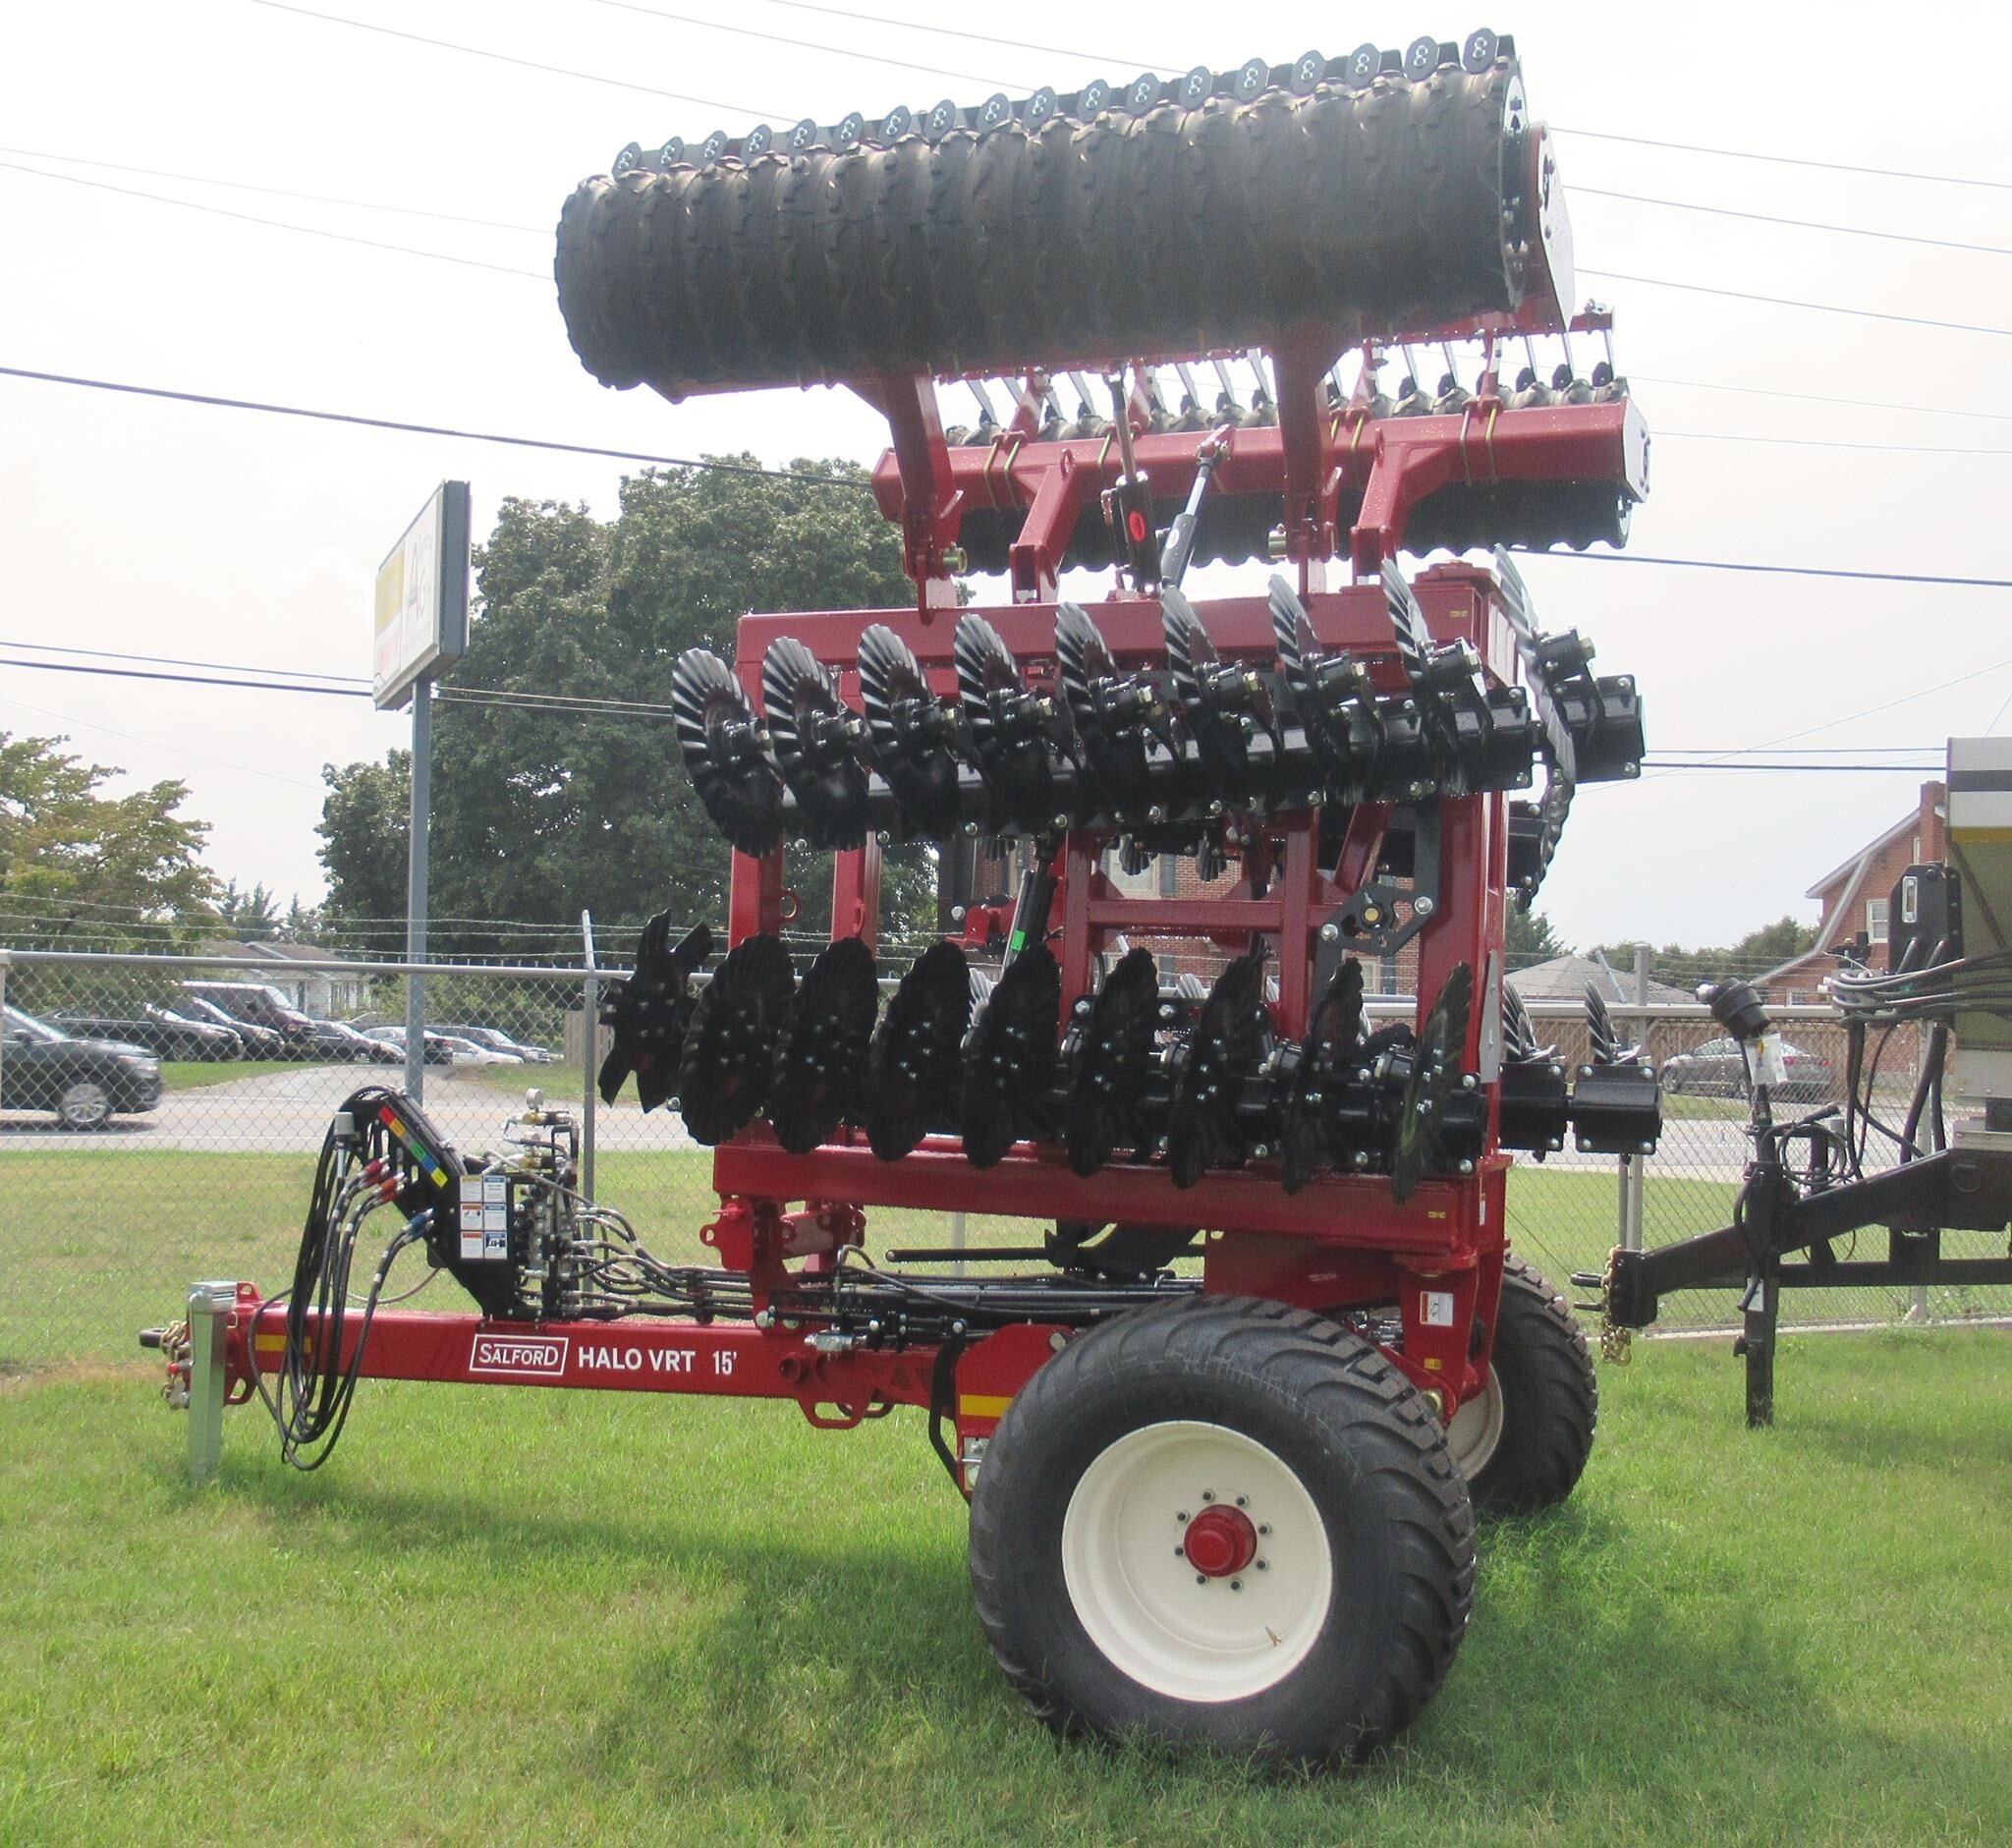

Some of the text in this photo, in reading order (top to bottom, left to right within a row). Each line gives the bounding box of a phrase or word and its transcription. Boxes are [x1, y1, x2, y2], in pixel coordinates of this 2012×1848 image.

[478, 1343, 559, 1367] SALFORD
[578, 1346, 737, 1375] HALO VRT 15'
